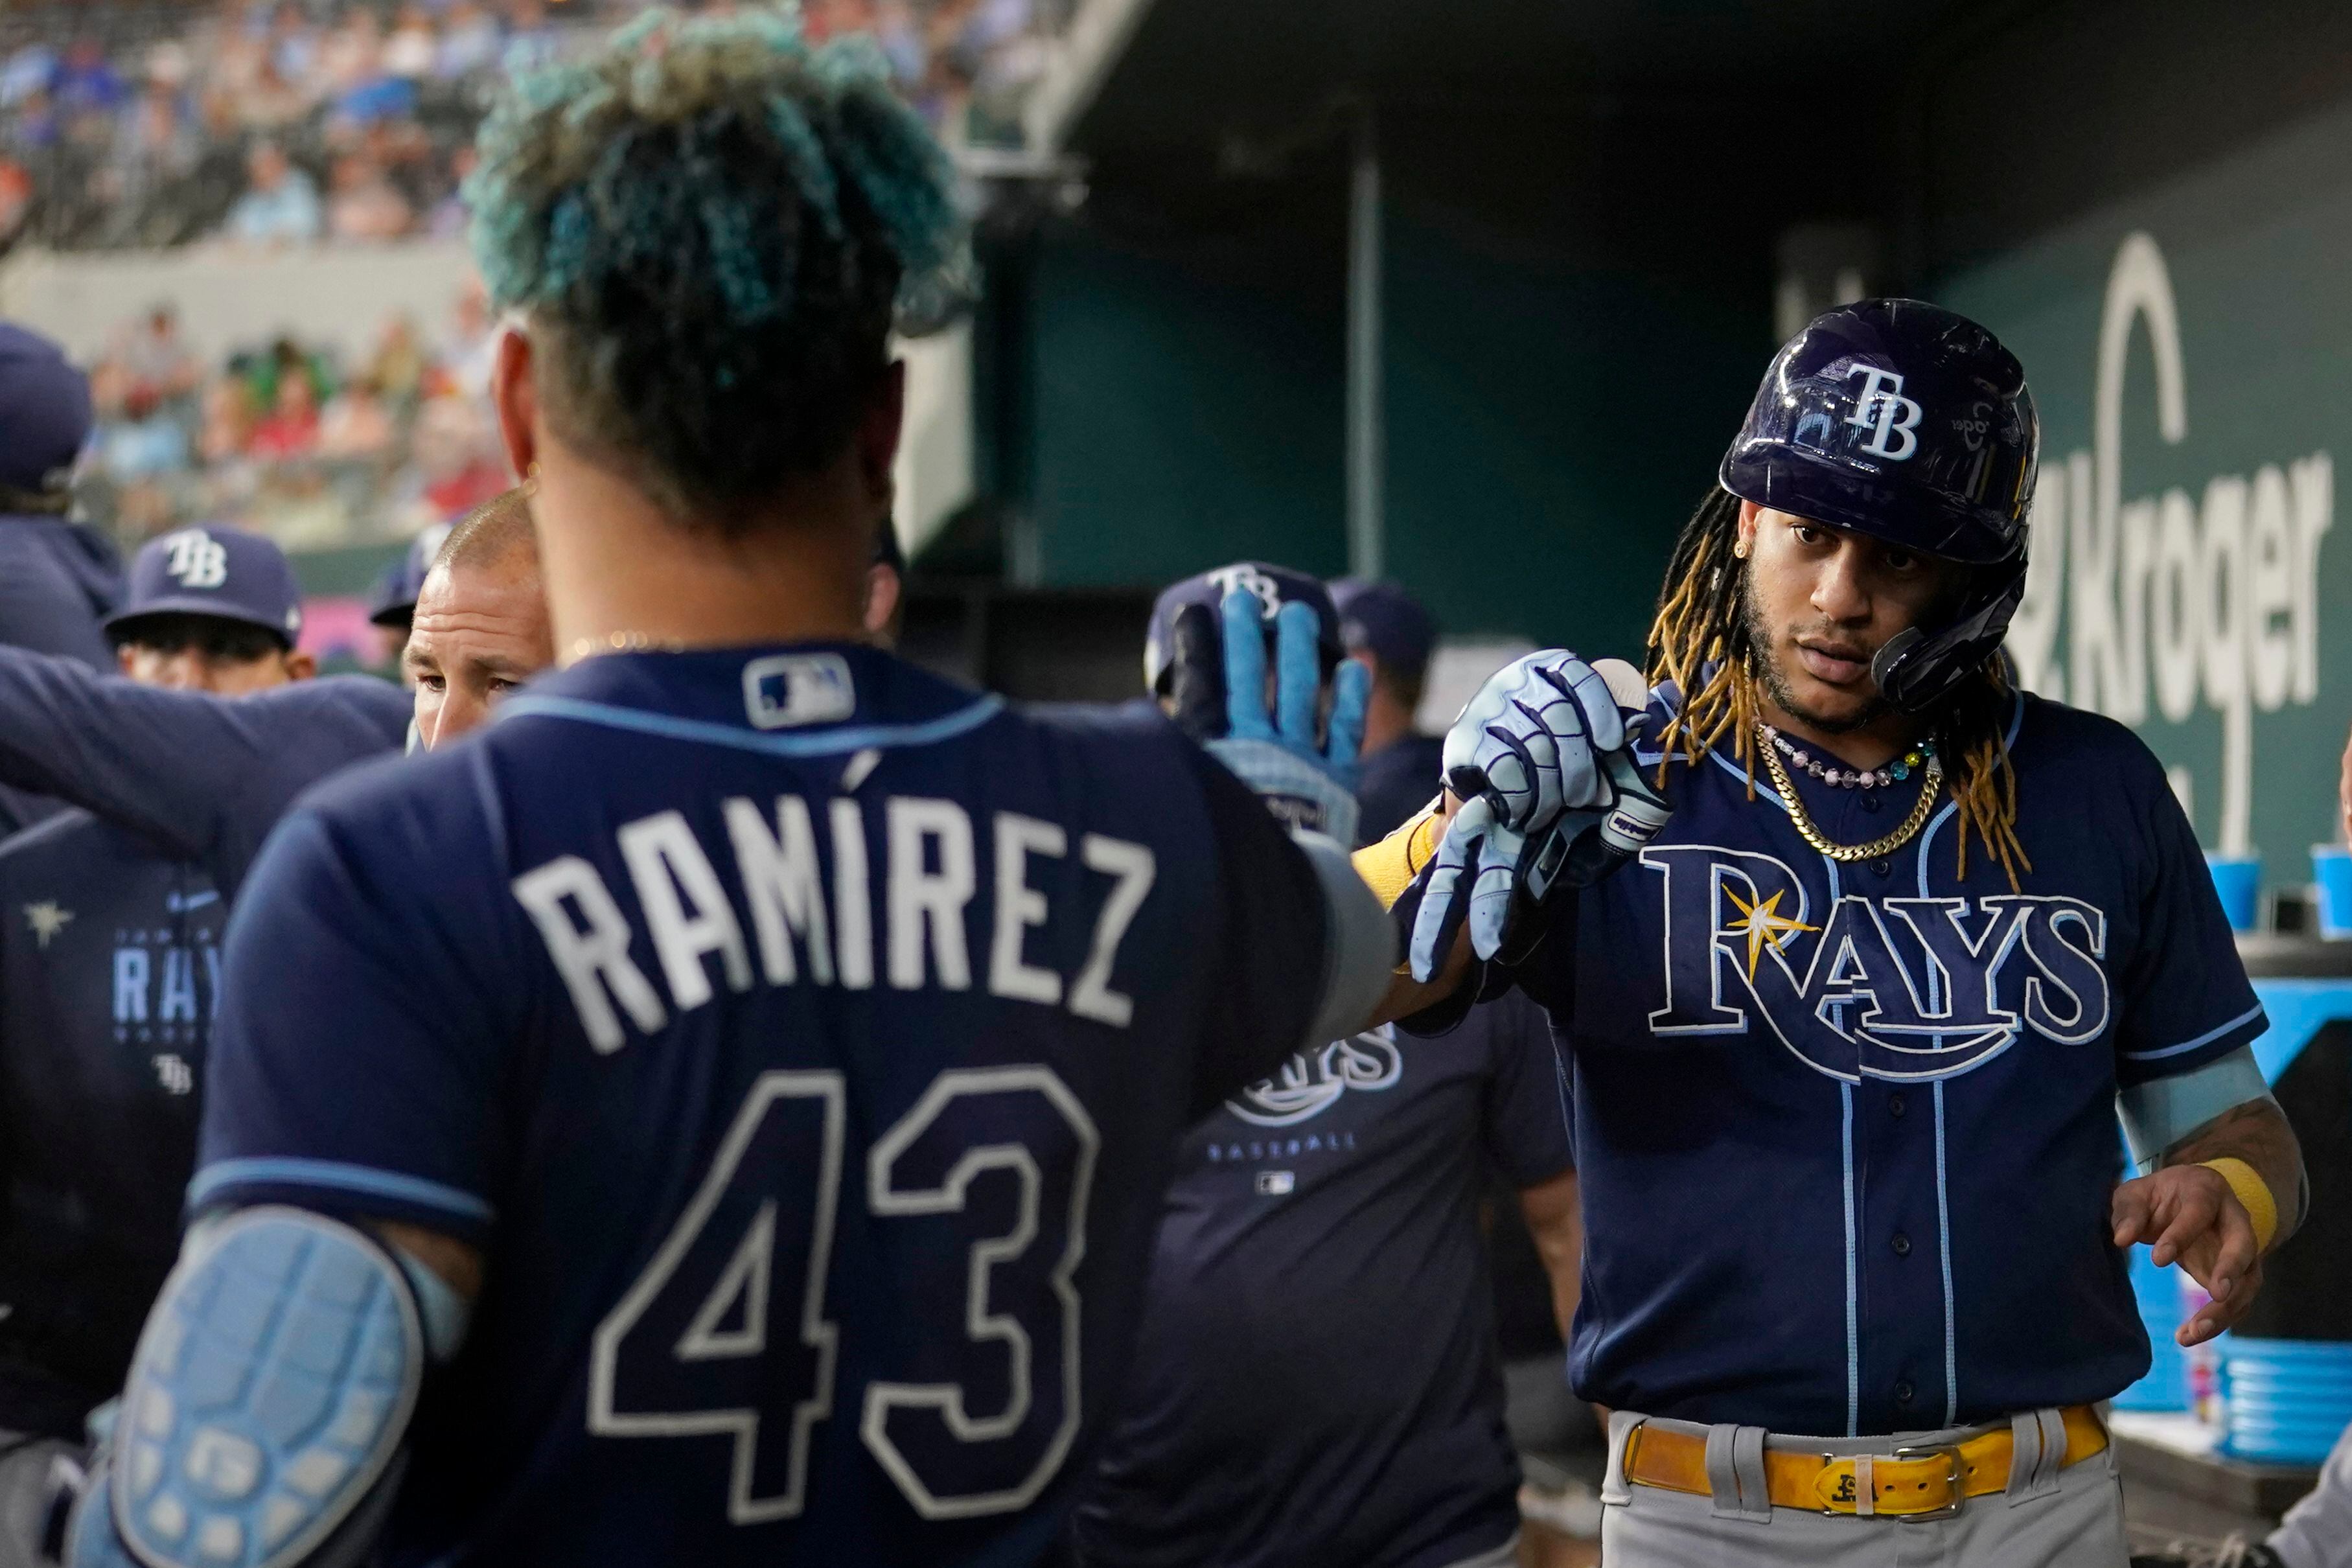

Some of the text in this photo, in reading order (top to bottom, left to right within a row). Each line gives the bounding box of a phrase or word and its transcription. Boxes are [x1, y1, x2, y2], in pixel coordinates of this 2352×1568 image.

[1845, 362, 1923, 461] TB
[163, 529, 227, 588] TB
[2070, 231, 2333, 853] Kroger
[512, 748, 1157, 1054] RAMÍREZ
[1639, 844, 2110, 1085] RAYS
[1207, 1133, 1355, 1161] BASEBALL
[586, 1063, 1101, 1525] 43
